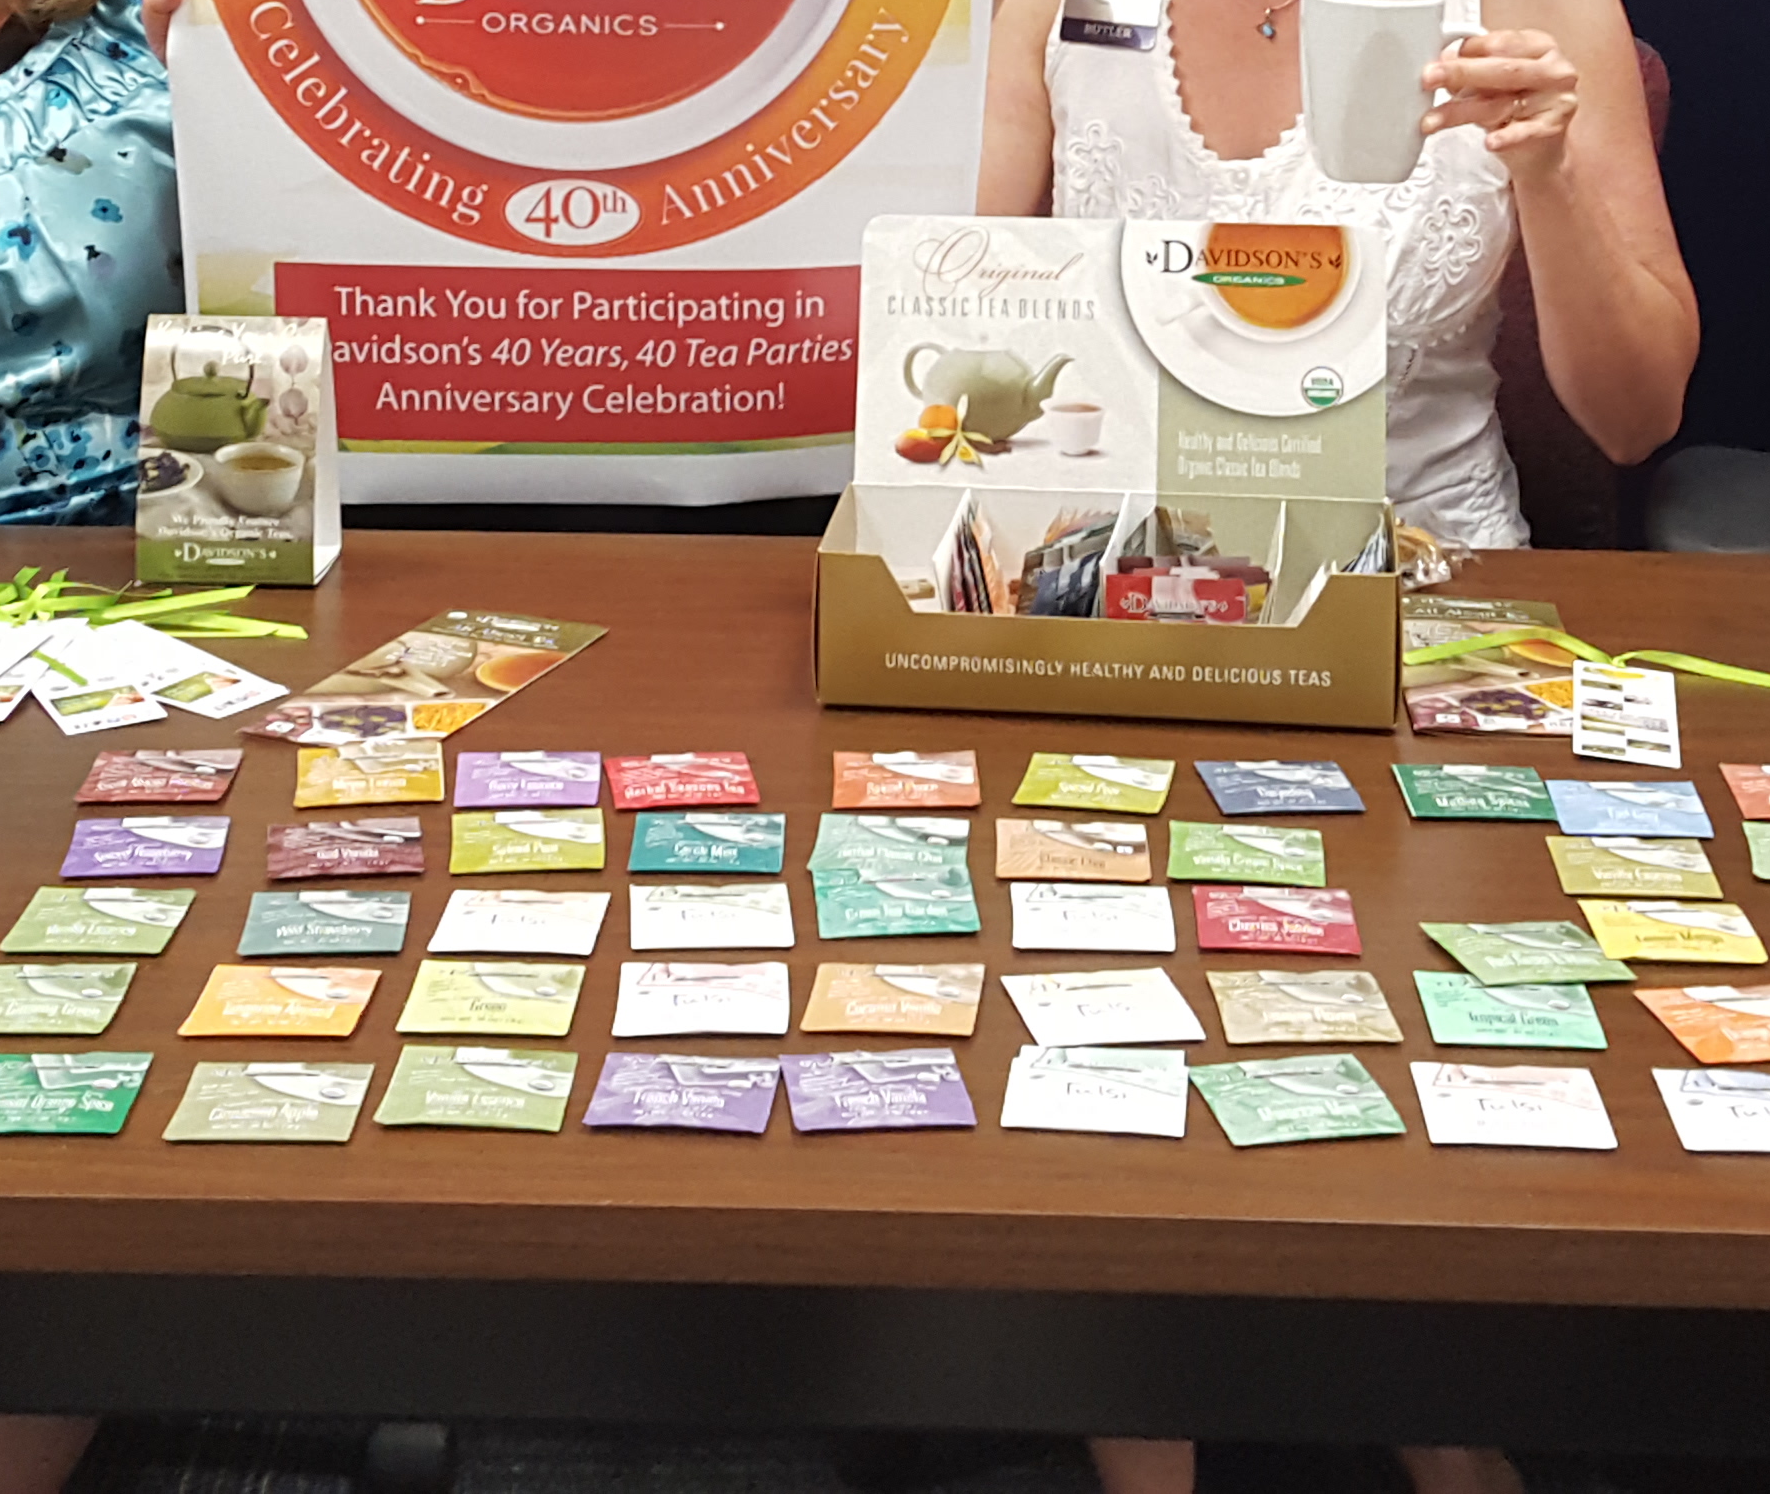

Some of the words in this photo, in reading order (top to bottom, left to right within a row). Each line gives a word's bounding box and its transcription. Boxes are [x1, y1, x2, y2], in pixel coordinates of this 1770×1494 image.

[481, 11, 659, 37] ORGANICS
[248, 0, 489, 228] Celebrating
[523, 185, 629, 241] 40th
[659, 5, 912, 227] Anniversary
[1161, 239, 1323, 274] DAVIDSON'S
[334, 285, 437, 320] Thank
[444, 288, 507, 321] You
[516, 289, 564, 321] for
[573, 290, 785, 328] Participating
[796, 291, 826, 319] in
[331, 334, 483, 366] avidson's
[491, 337, 532, 367] 40
[540, 339, 629, 372] Years,
[636, 338, 677, 368] 40
[685, 337, 738, 368] Tea
[747, 334, 853, 368] Parties
[375, 382, 575, 421] Anniversary
[582, 383, 786, 415] Celebration!
[884, 652, 1064, 677] UNCOMPROMISINGLY
[1069, 662, 1143, 681] HEALTHY
[1148, 664, 1186, 683] AND
[1191, 666, 1283, 686] DELICIOUS
[1289, 669, 1332, 688] TEAS
